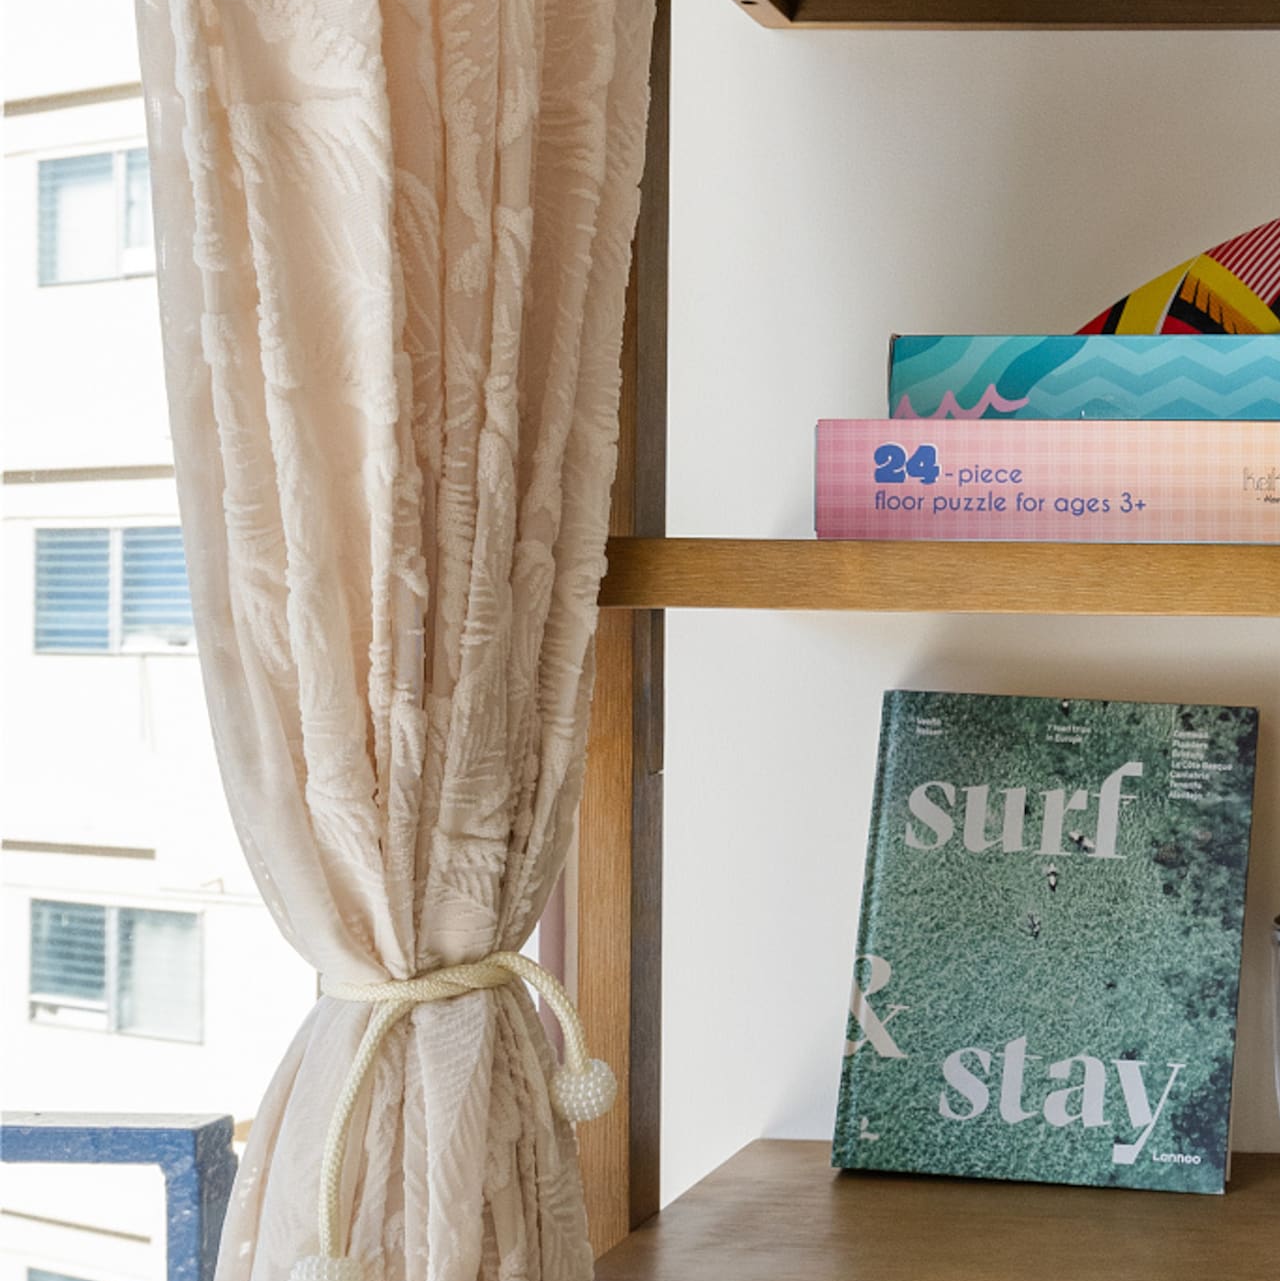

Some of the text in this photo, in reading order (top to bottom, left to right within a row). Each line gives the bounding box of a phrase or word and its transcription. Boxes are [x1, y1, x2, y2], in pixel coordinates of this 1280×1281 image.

[874, 490, 1147, 517] floor puzzle for ages 3+
[904, 762, 1144, 859] surf
[845, 954, 909, 1059] &
[938, 1035, 1187, 1165] stay
